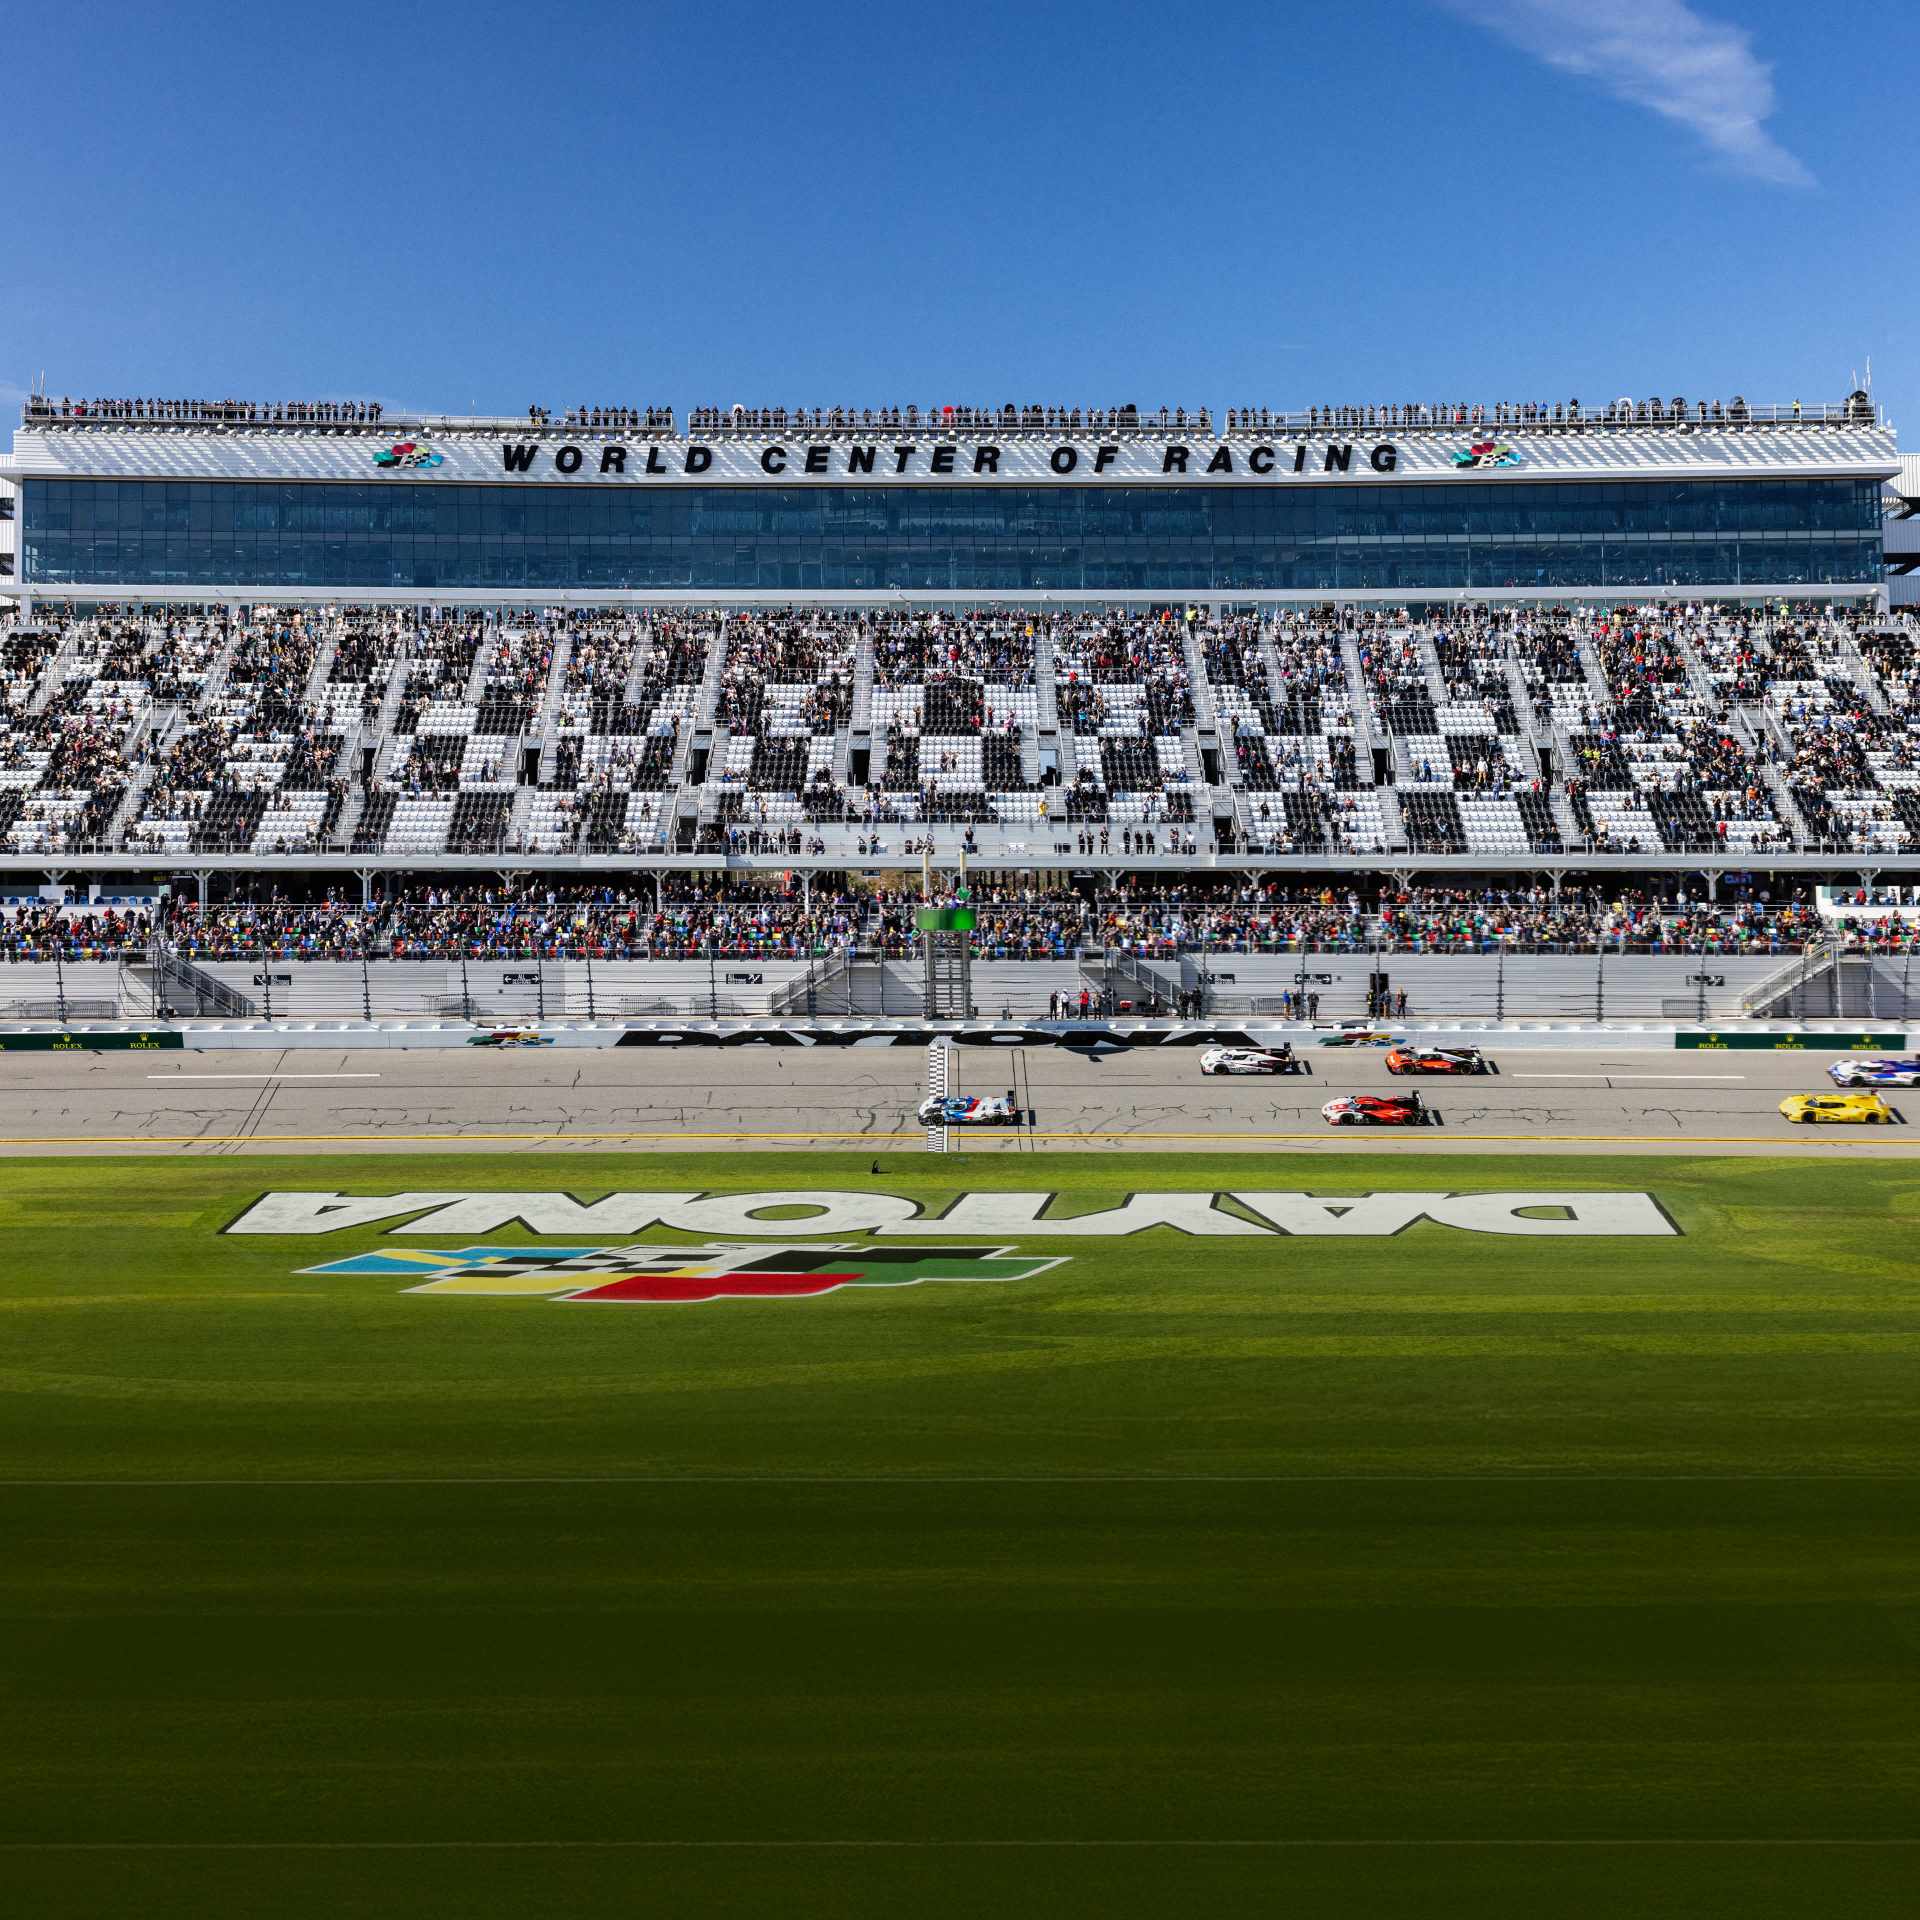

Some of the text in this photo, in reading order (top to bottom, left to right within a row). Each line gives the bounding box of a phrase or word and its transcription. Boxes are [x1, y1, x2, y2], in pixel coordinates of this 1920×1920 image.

[502, 444, 1397, 475] WORLD CENTER OF RACING
[615, 1030, 1261, 1047] DAYTONA
[217, 1192, 1686, 1237] DAYTONA
